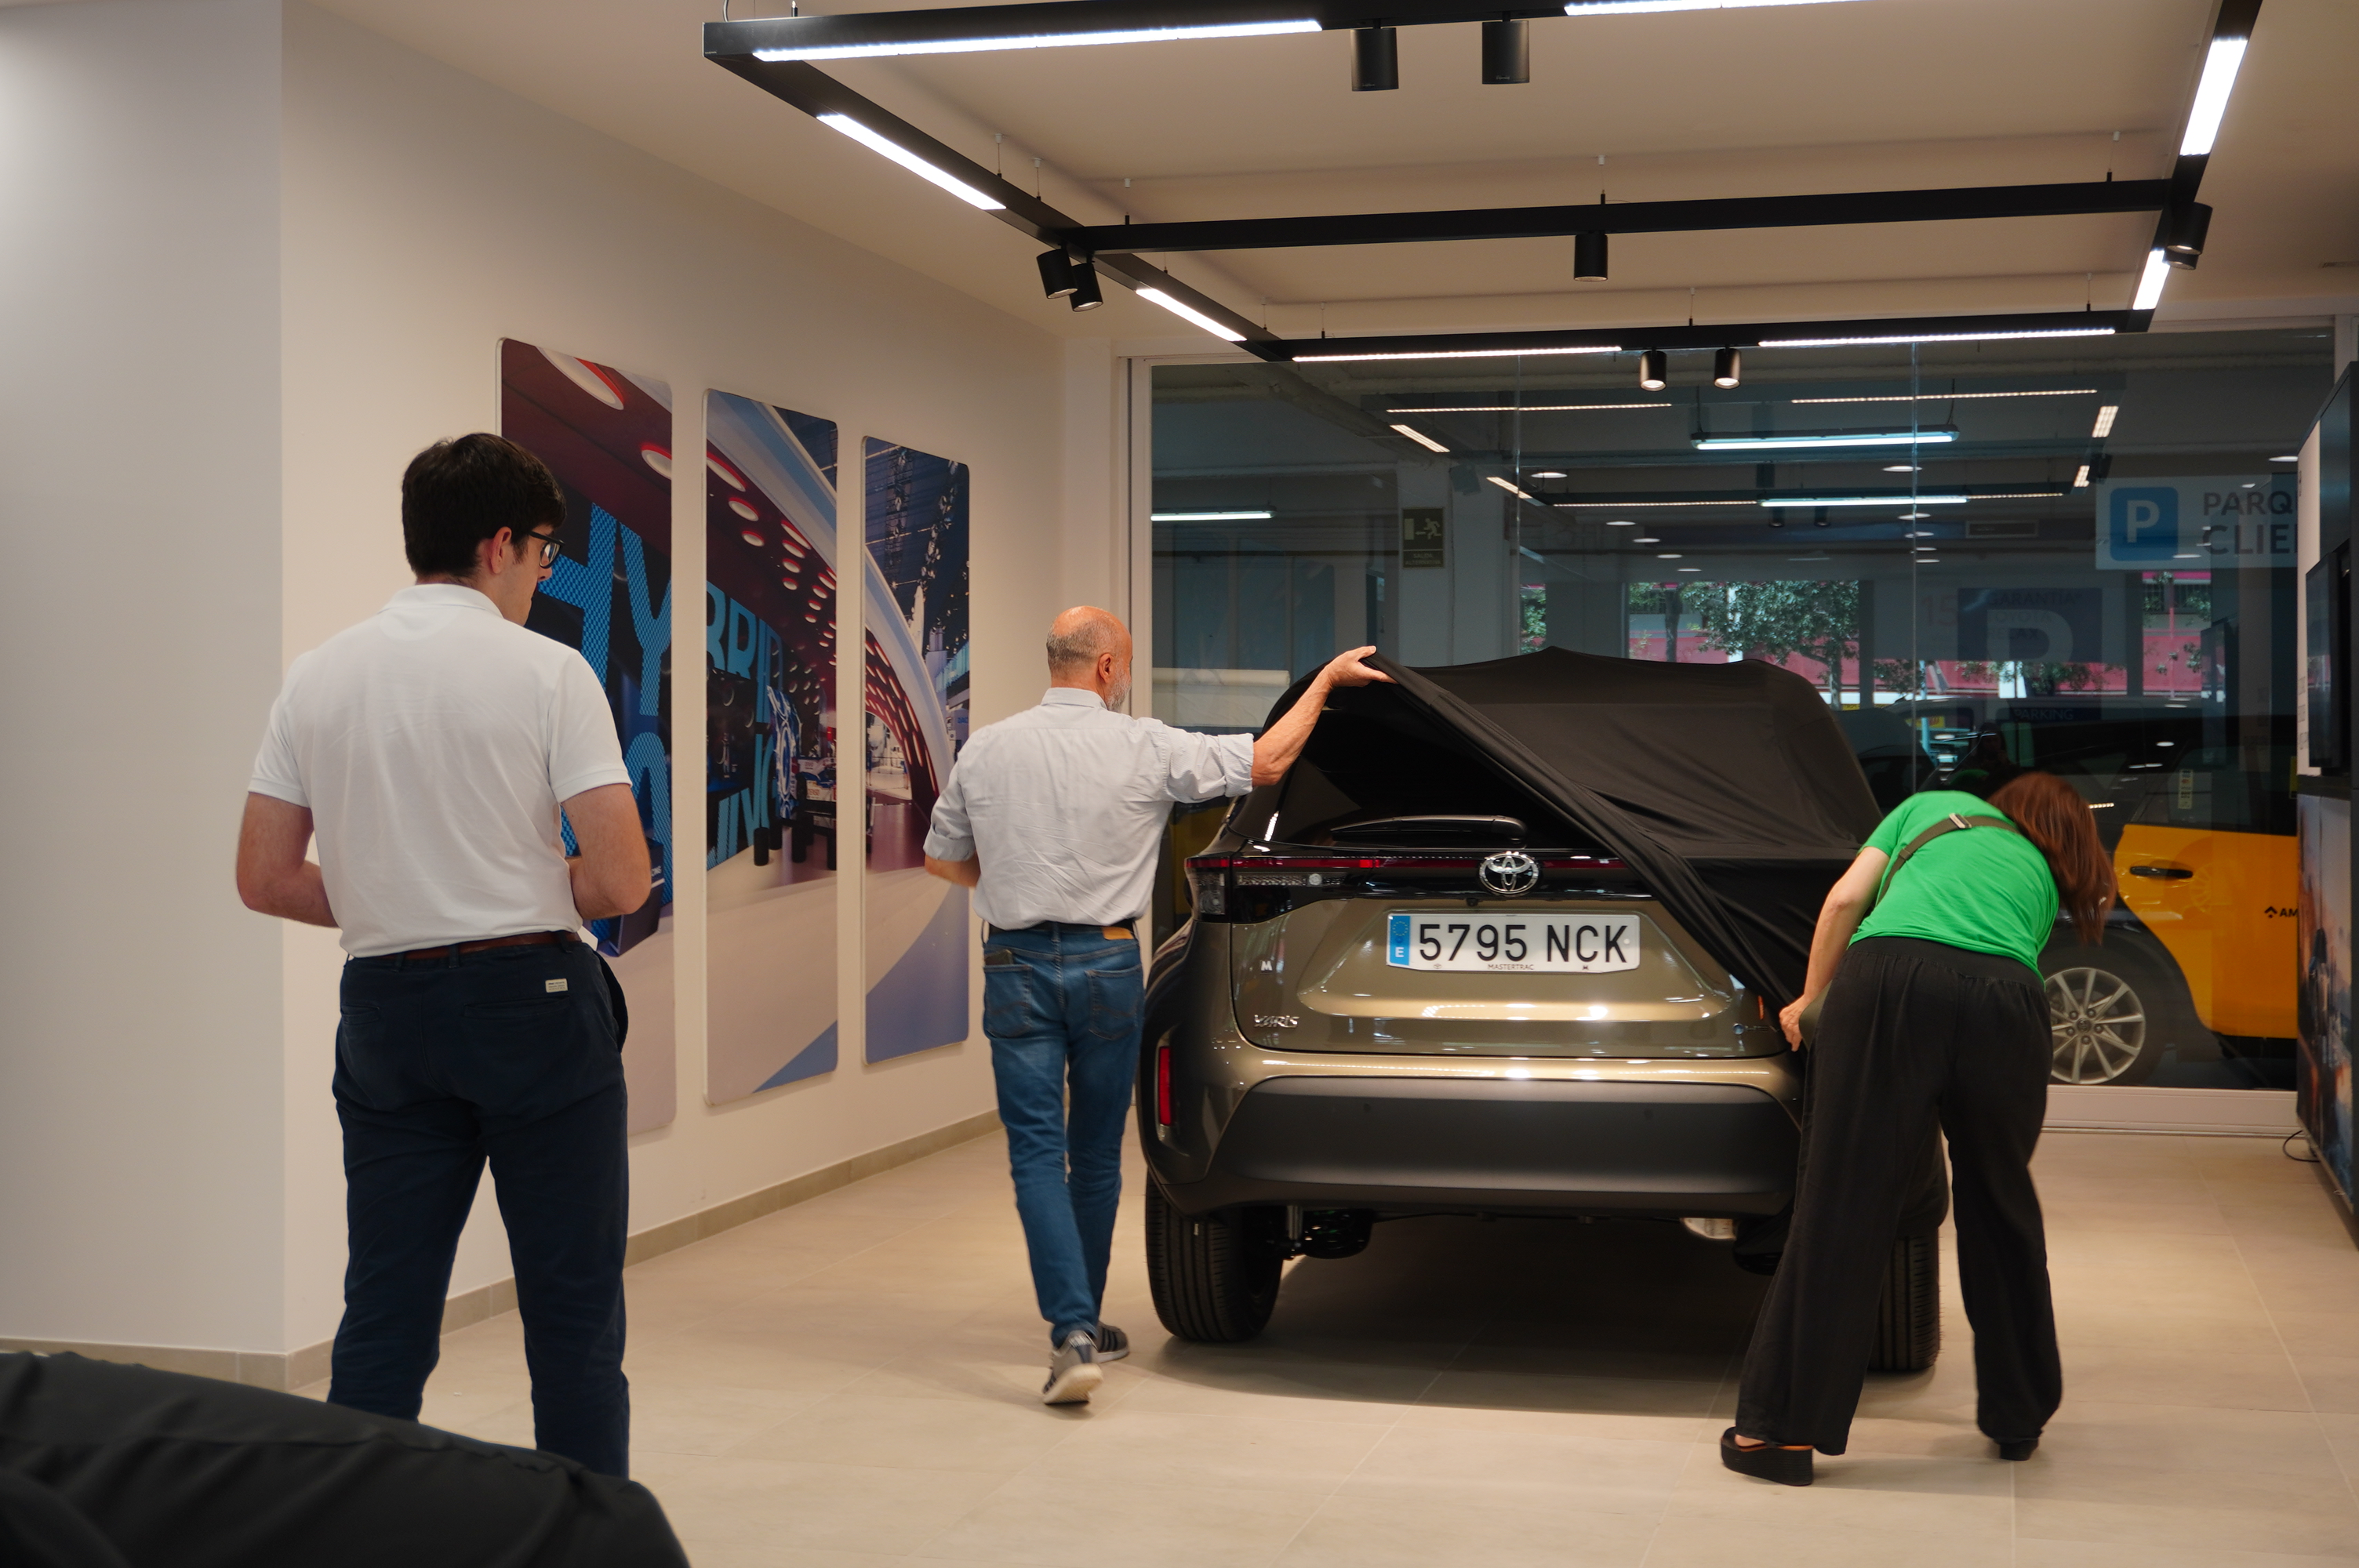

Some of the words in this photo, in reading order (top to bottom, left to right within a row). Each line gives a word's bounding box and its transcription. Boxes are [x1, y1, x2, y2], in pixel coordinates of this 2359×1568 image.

[2203, 490, 2297, 516] PARQ
[2127, 499, 2160, 543] P
[2202, 524, 2297, 554] CLIE
[1394, 946, 1405, 957] E
[1419, 924, 1527, 962] 5795
[1547, 924, 1628, 963] NCK
